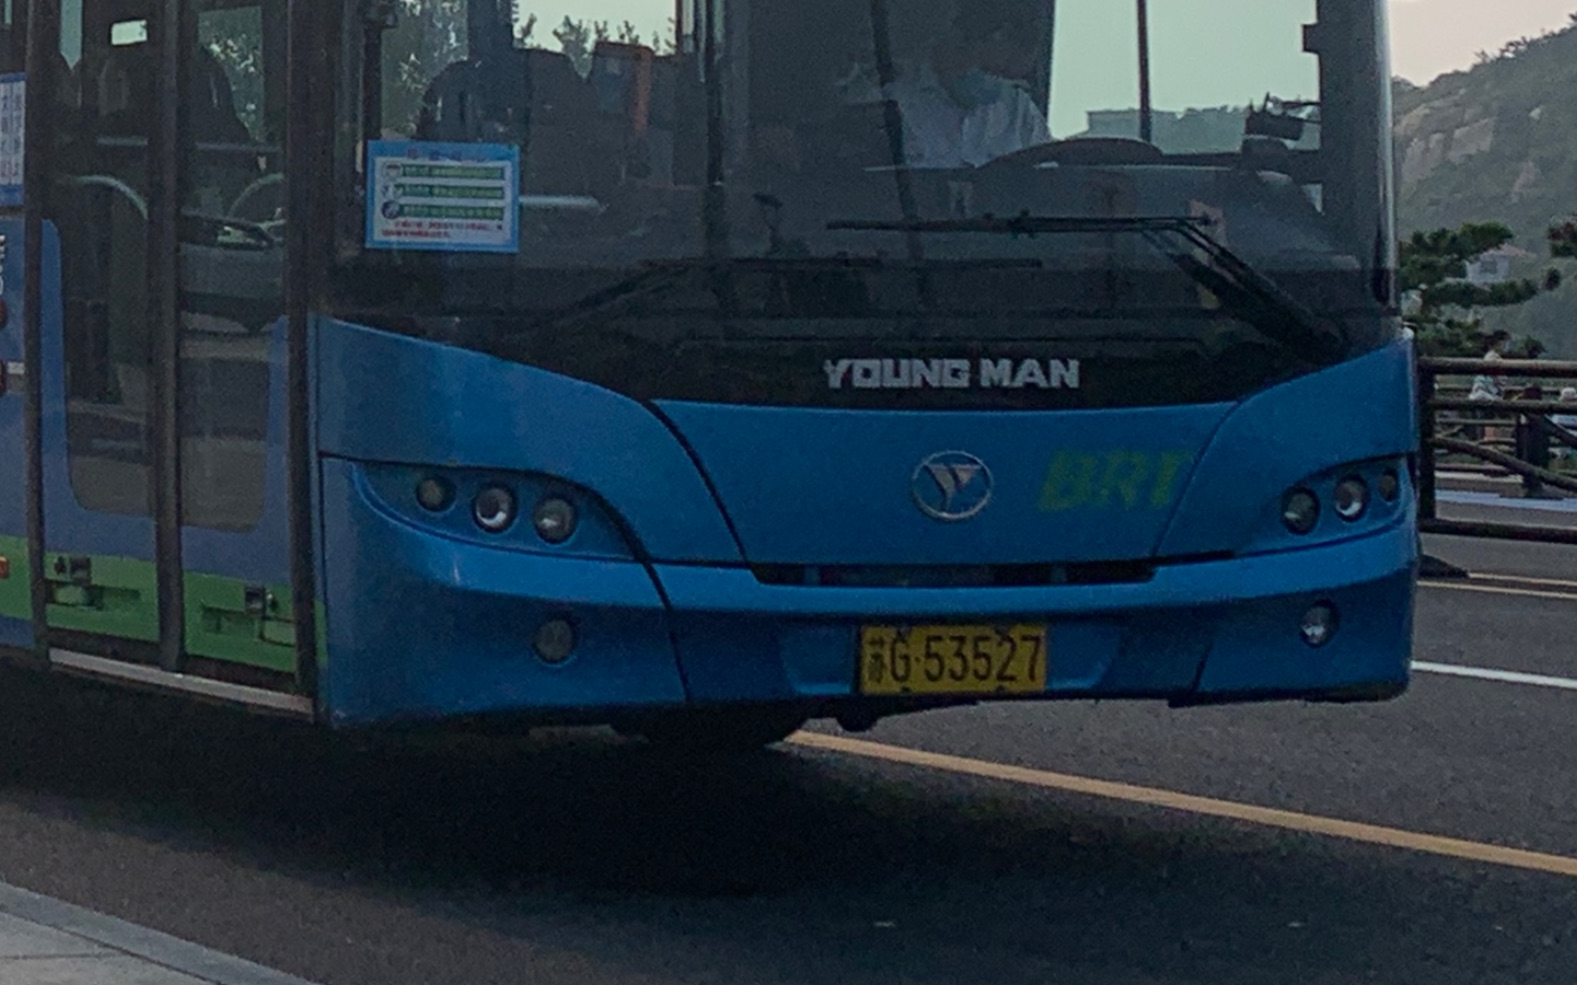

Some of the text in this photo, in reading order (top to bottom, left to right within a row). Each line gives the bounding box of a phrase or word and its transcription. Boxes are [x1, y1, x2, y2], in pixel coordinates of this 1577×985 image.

[825, 358, 1079, 389] YOUNG MAN
[1038, 449, 1197, 511] BRT
